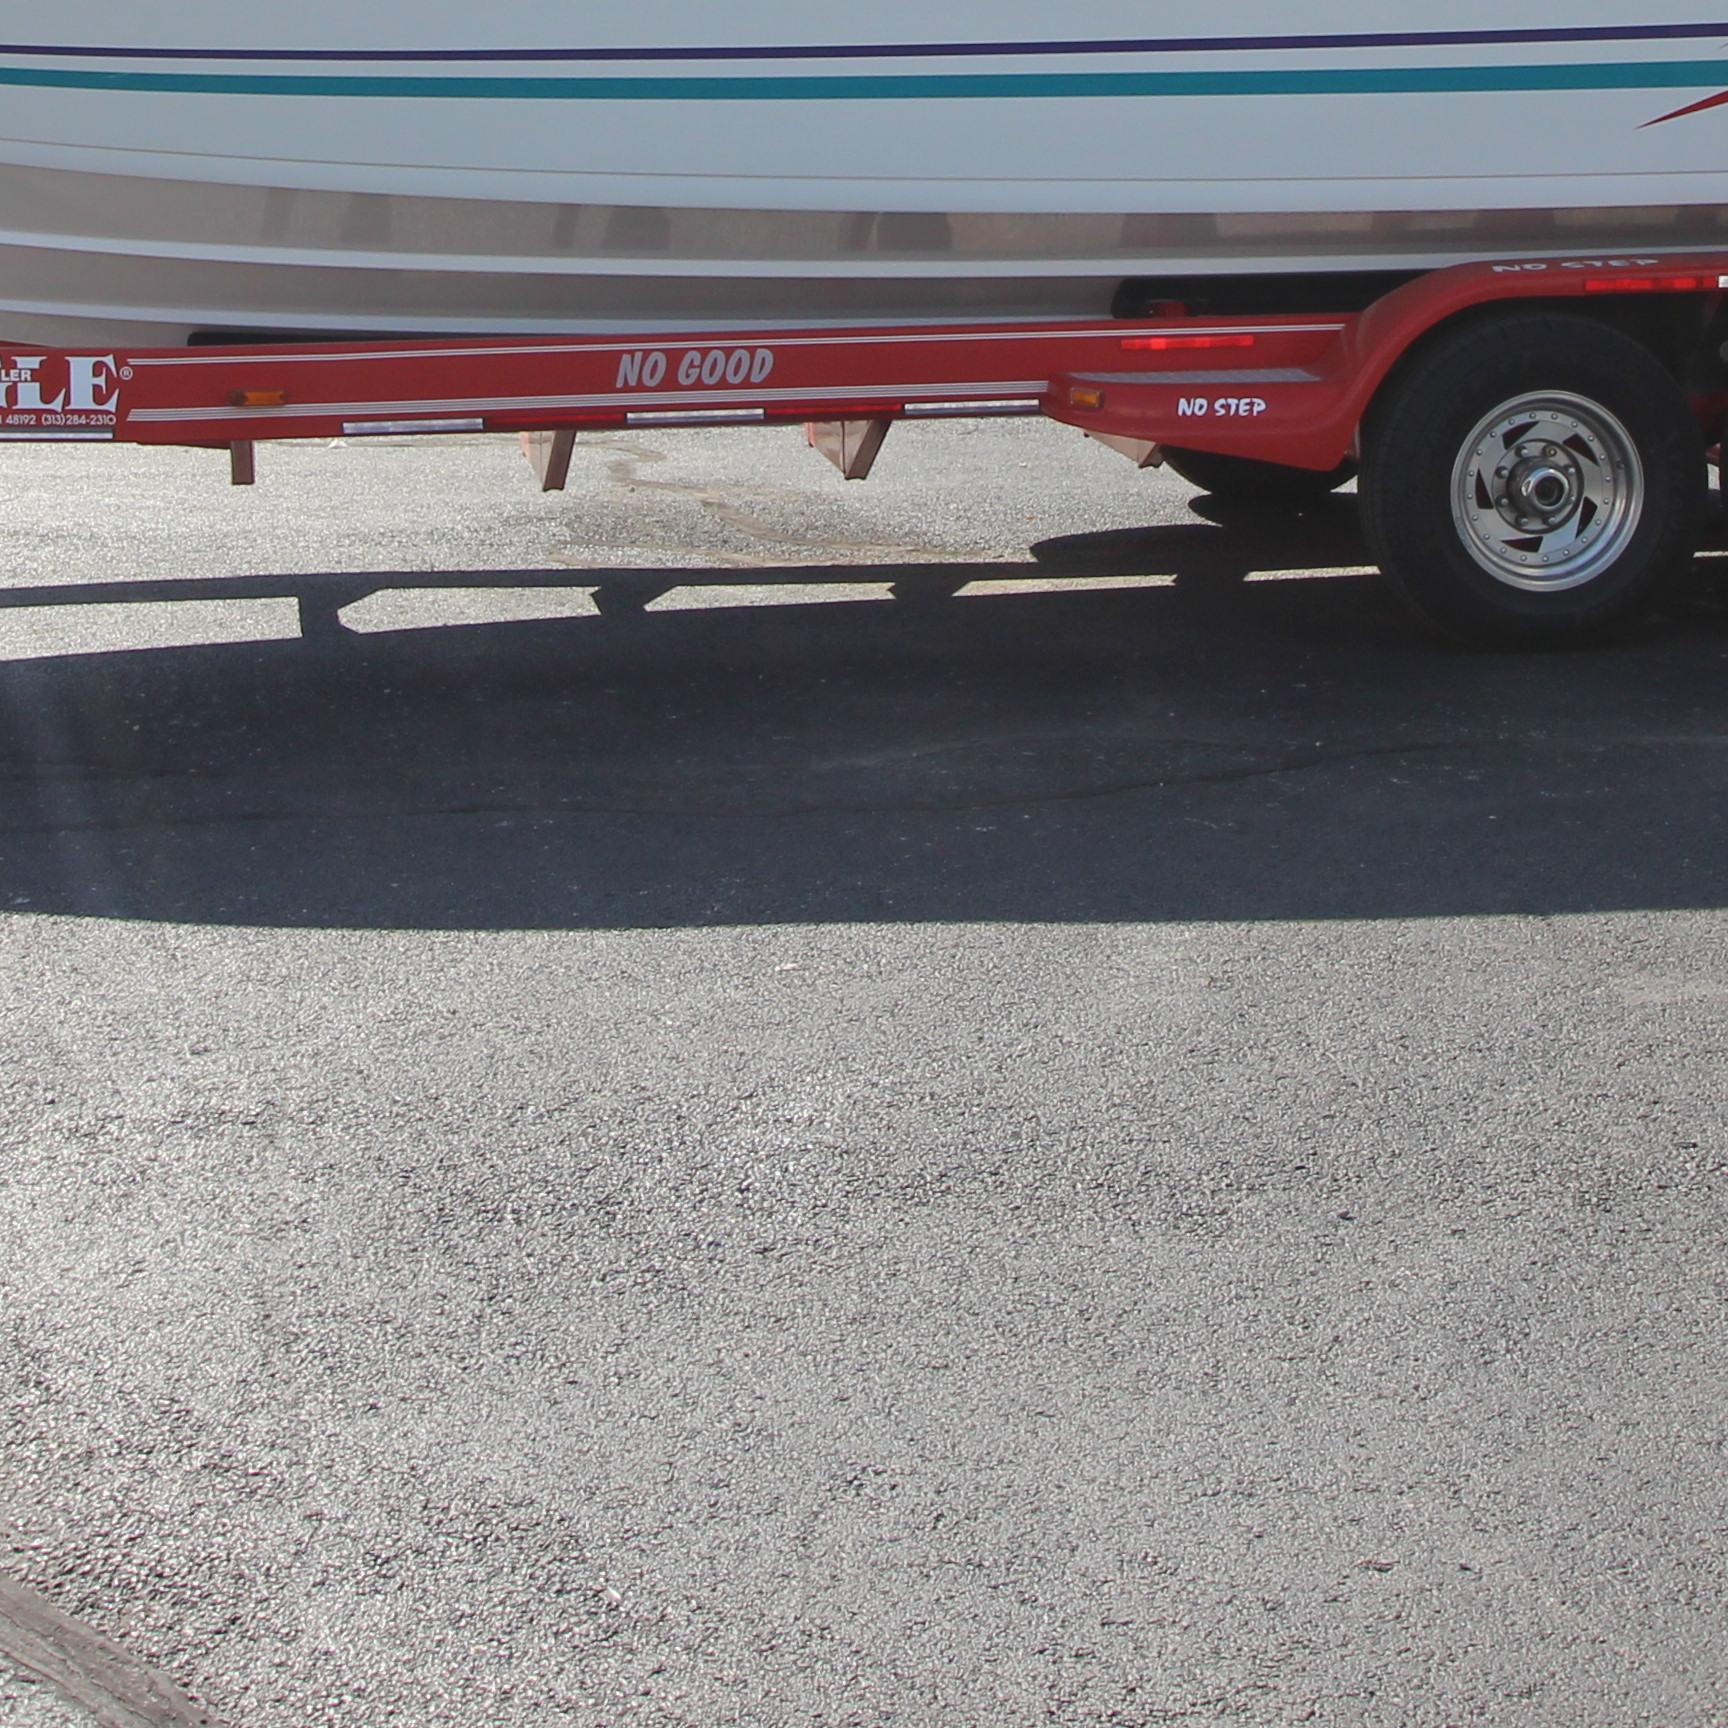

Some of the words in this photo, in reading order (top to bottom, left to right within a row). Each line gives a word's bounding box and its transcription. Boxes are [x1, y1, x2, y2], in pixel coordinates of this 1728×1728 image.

[1492, 262, 1547, 273] NO
[615, 351, 667, 388] NO
[677, 348, 774, 385] GOOD
[1177, 398, 1208, 417] NO
[1214, 398, 1266, 417] STEP
[6, 414, 37, 425] 48192
